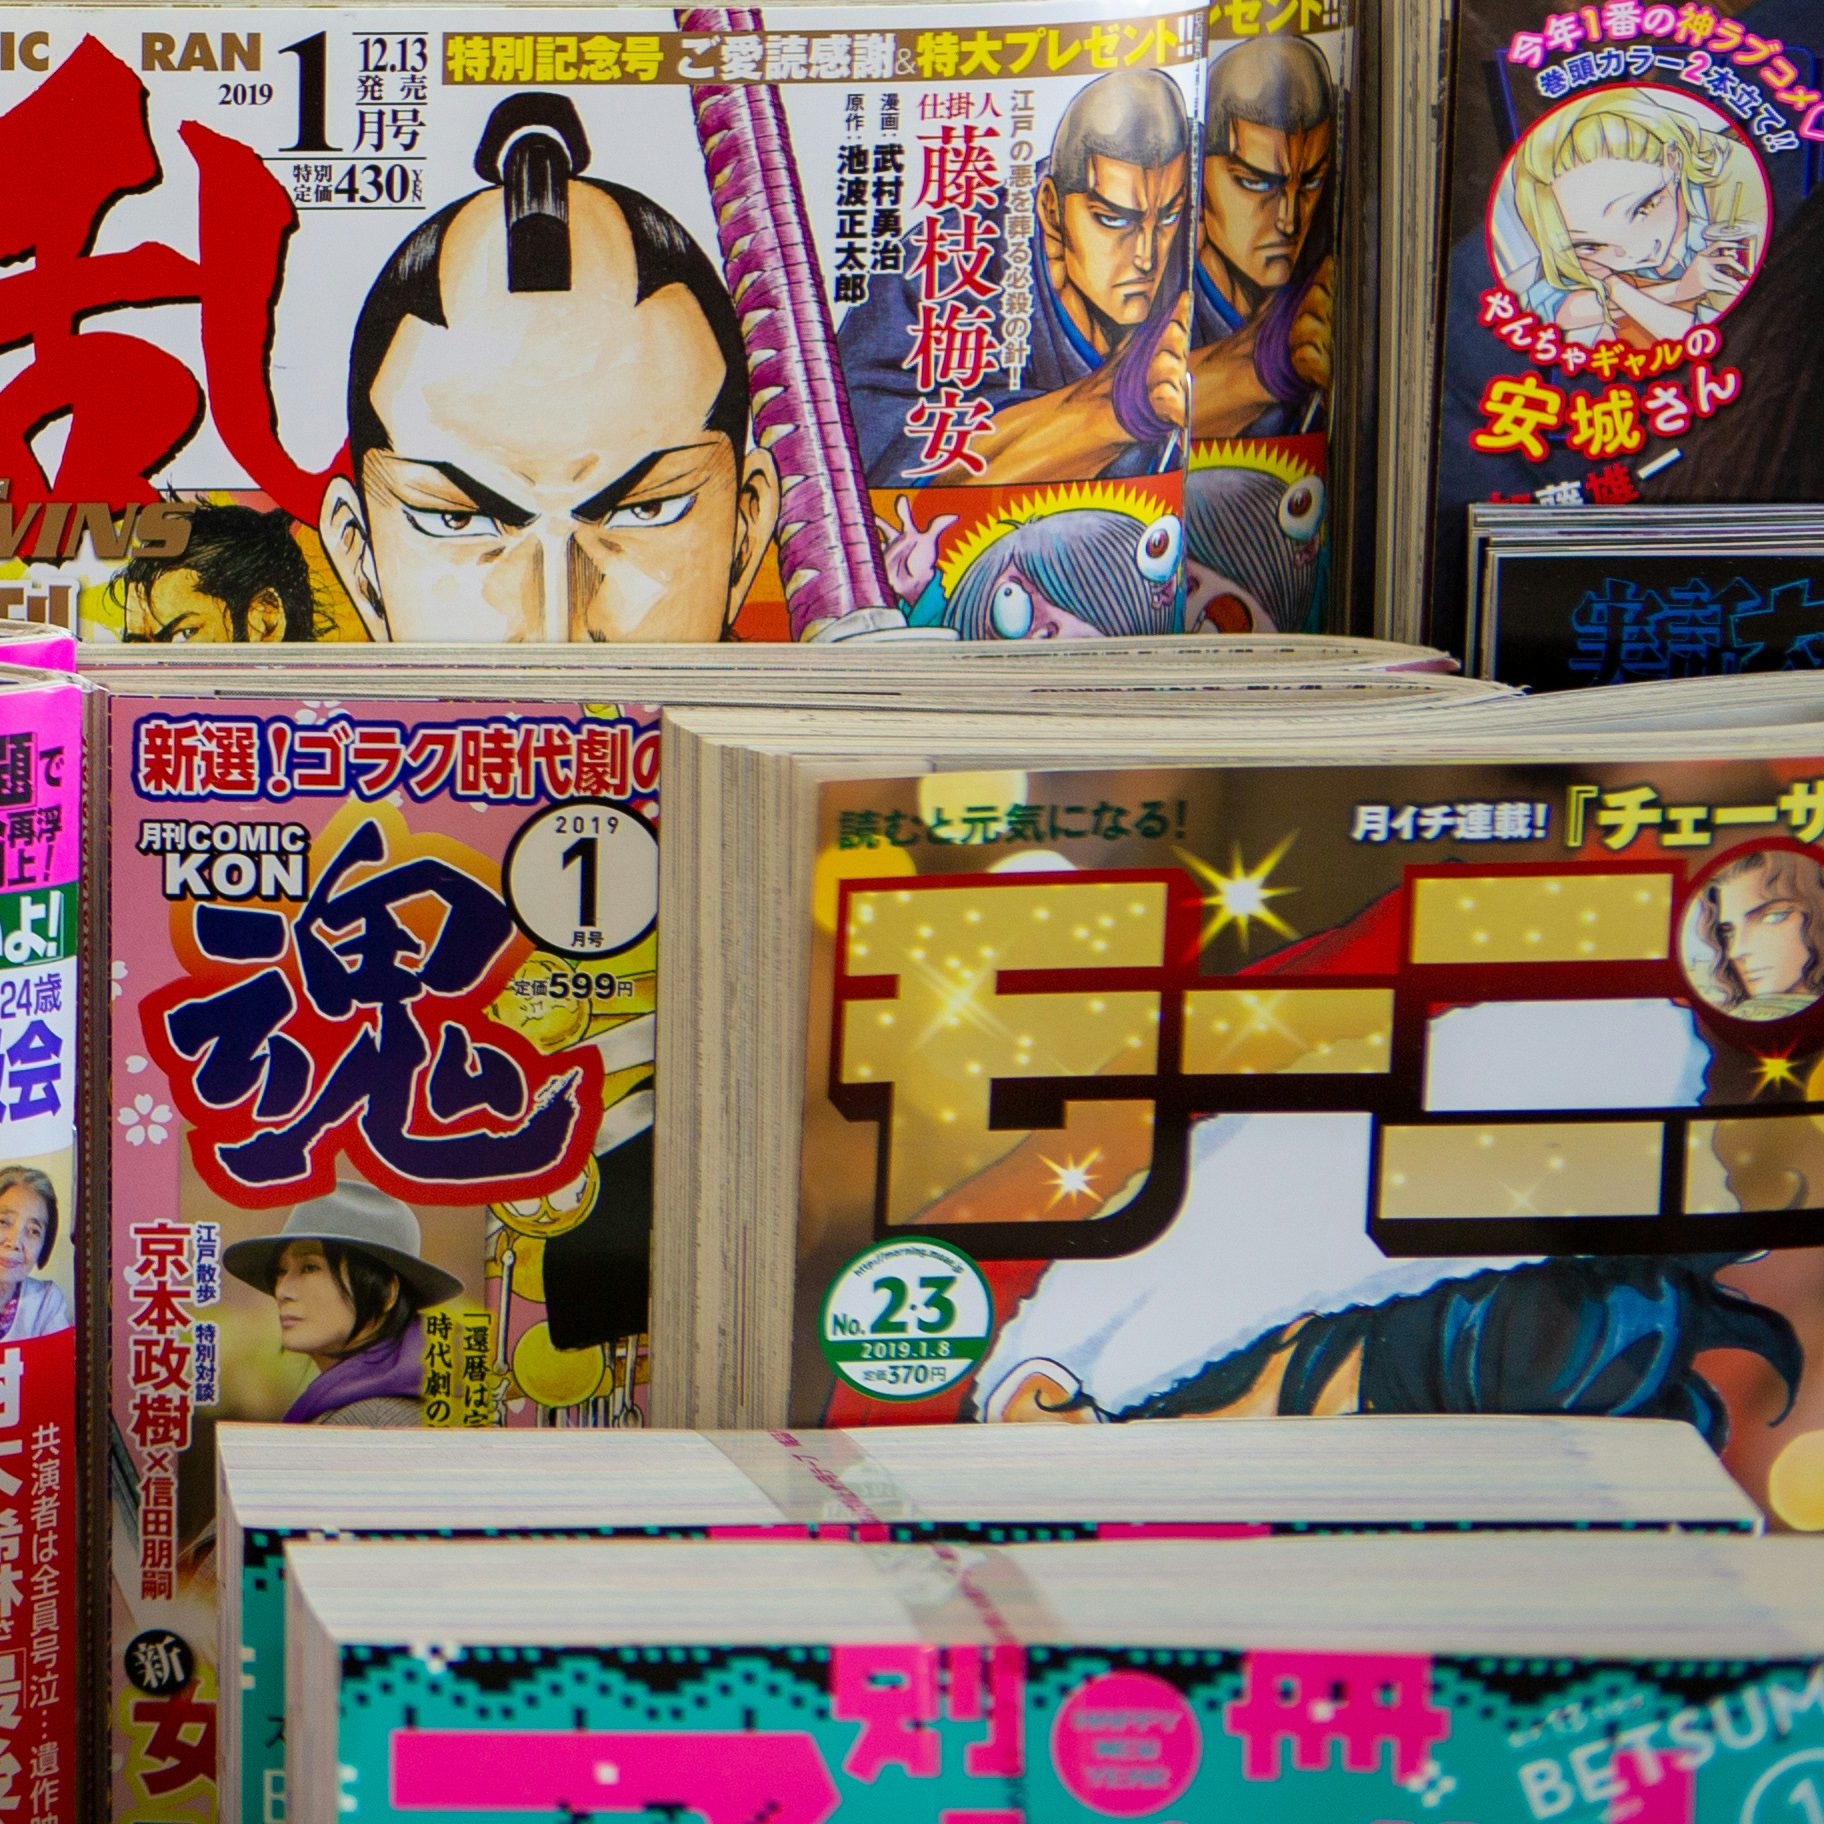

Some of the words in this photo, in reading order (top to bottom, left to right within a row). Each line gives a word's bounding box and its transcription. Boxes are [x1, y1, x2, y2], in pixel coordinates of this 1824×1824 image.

[140, 31, 263, 73] RAN
[356, 35, 429, 74] 12.13
[447, 32, 664, 82] 特別記念号
[216, 81, 275, 108] 2019
[355, 73, 429, 104] 発売
[917, 92, 1002, 121] 仕掛人
[351, 106, 428, 153] 月号
[332, 162, 411, 206] 430
[902, 123, 1002, 479] 藤枝梅安
[1481, 287, 1721, 378] やんちゃギャルの
[1472, 368, 1742, 460] 安城さん
[554, 814, 620, 834] 2019
[164, 854, 306, 896] KON
[164, 817, 584, 1185] 魂
[512, 972, 634, 1000] 定価599円
[194, 1223, 219, 1306] 江戸散歩
[194, 1322, 218, 1403] 特別対談
[860, 1339, 952, 1361] 2019.1.8
